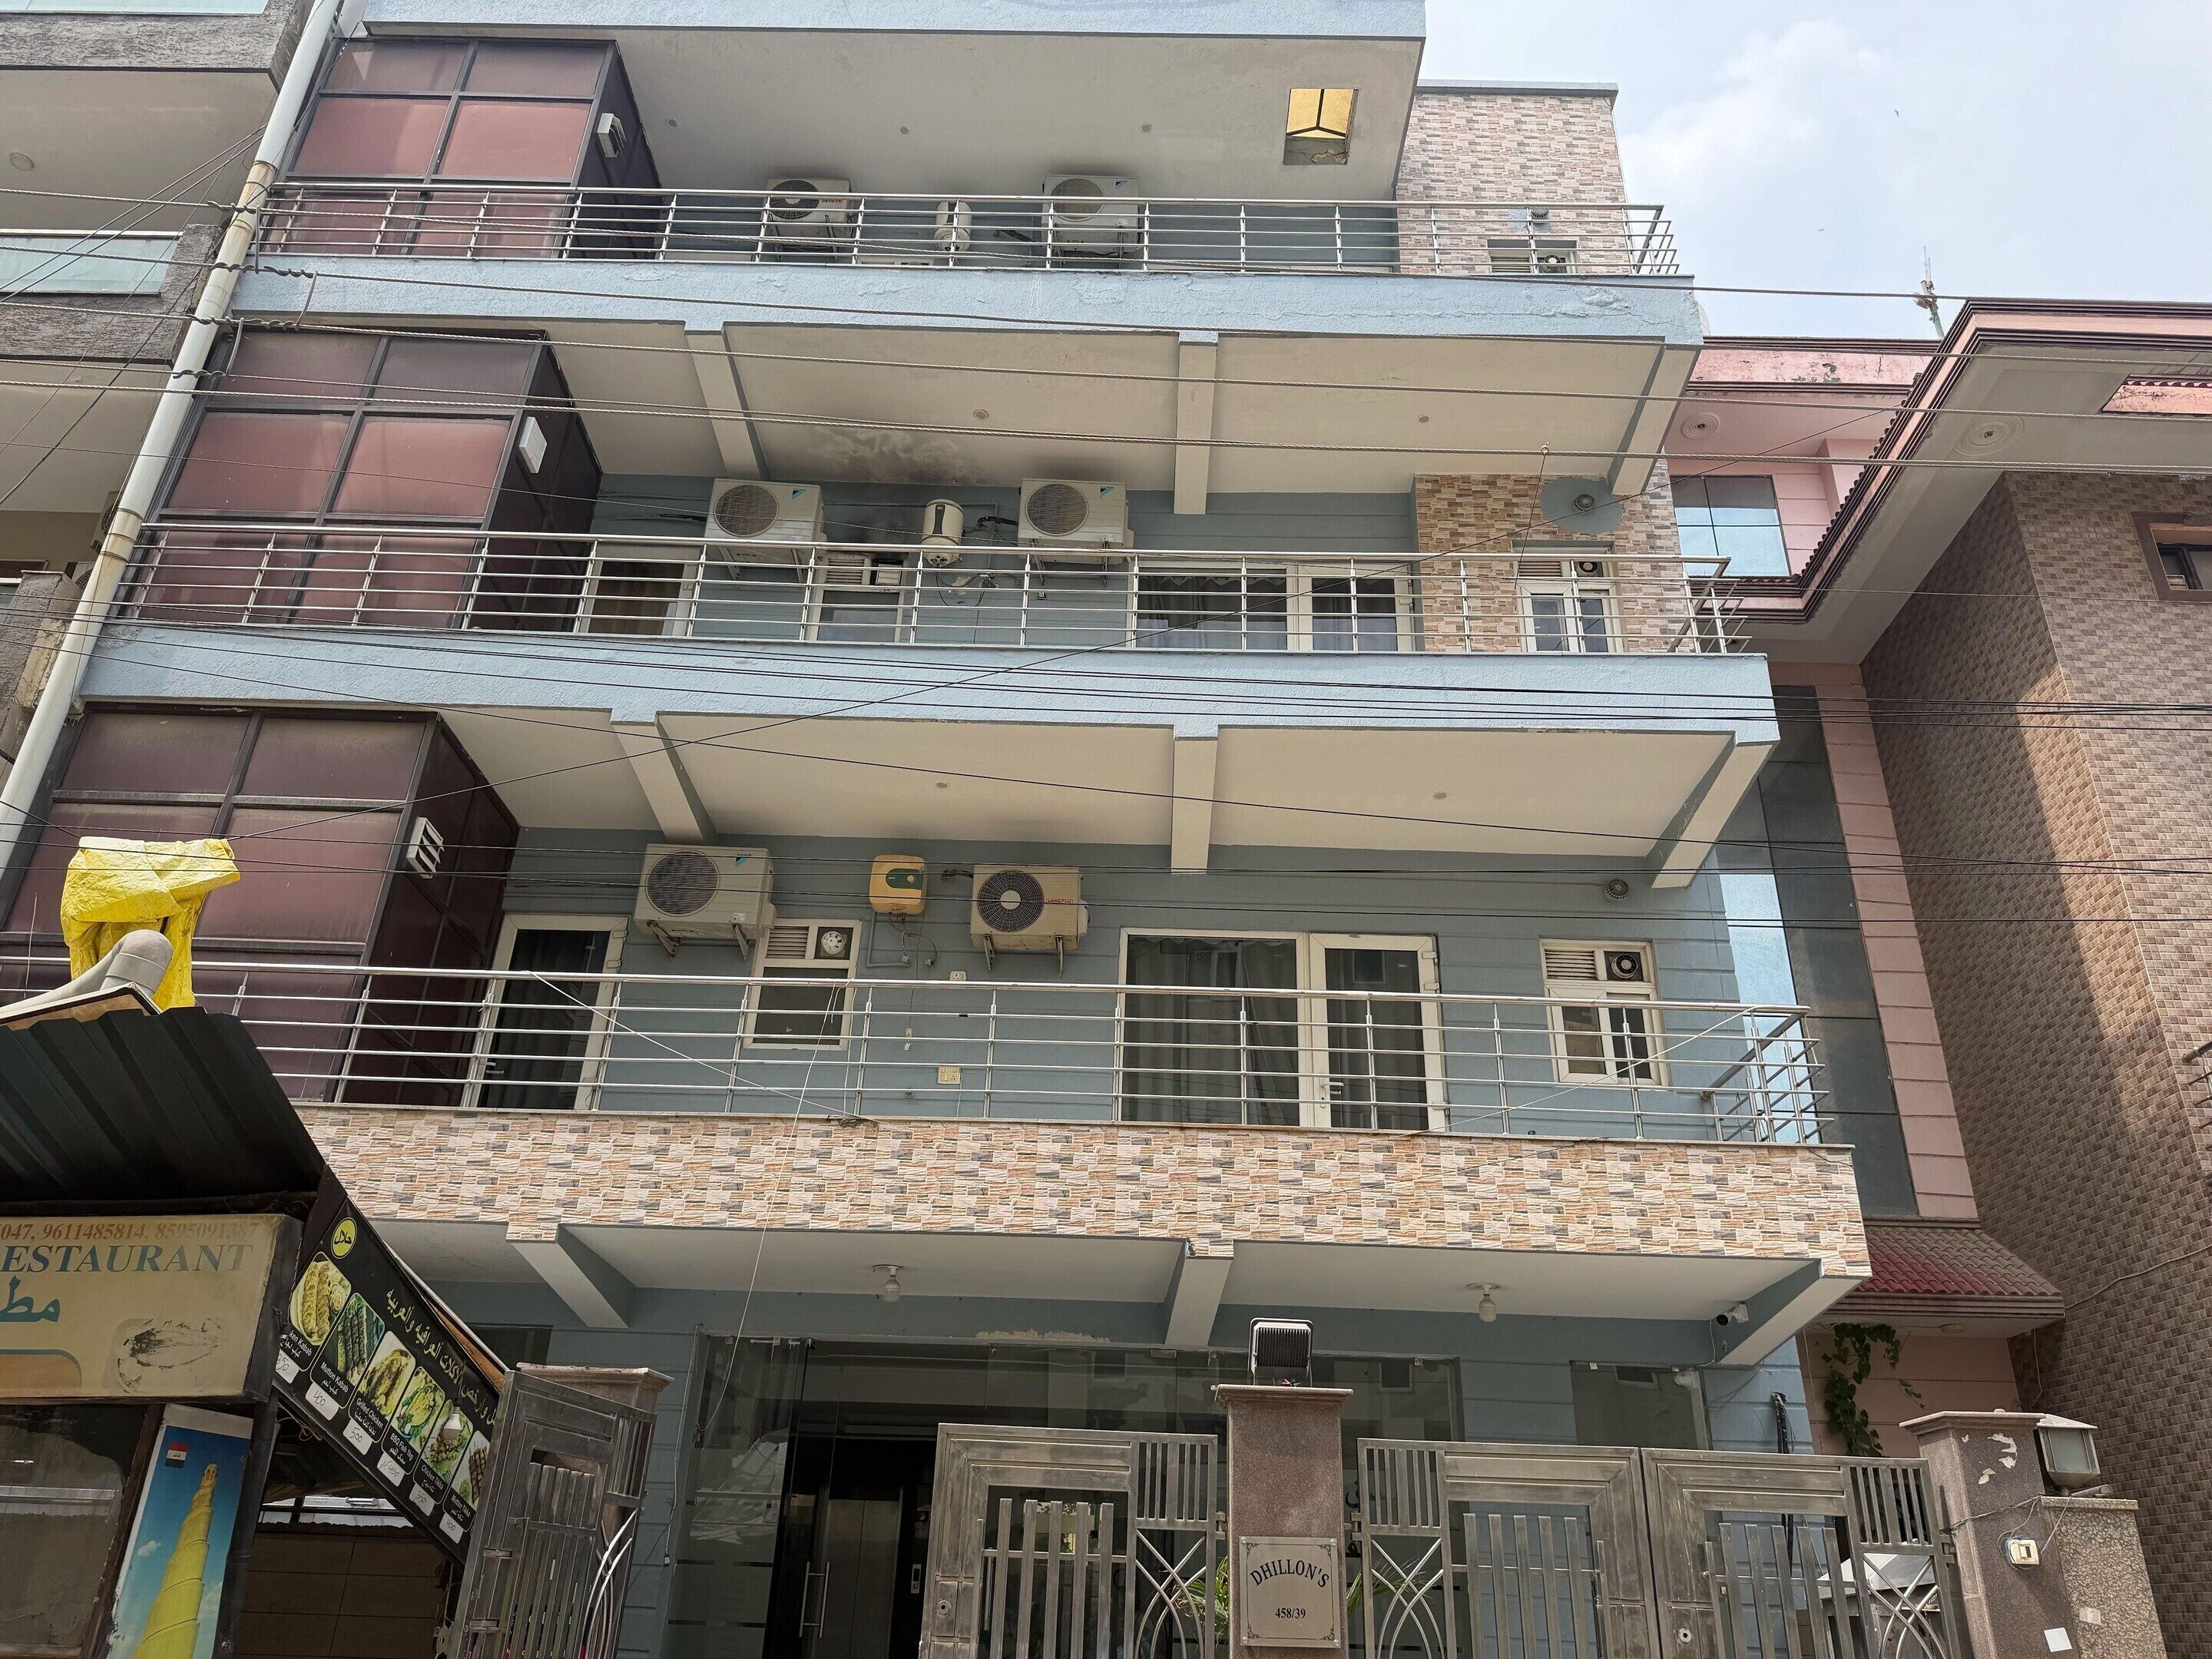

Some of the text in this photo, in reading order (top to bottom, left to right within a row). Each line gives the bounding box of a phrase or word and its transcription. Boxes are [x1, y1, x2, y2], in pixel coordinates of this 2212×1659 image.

[0, 1224, 35, 1243] 047,
[40, 1223, 148, 1243] 9611485814,
[334, 1229, 352, 1245] حلال
[289, 1330, 313, 1356] ken Kabab
[320, 1361, 349, 1393] Mutton Kabab
[313, 1390, 326, 1406] 400
[356, 1397, 383, 1429] Grilled Chicken
[349, 1426, 363, 1443] 500
[390, 1433, 400, 1445] BBQ
[399, 1442, 409, 1455] Fish
[421, 1464, 445, 1491] Chicken Tikka
[1250, 1559, 1330, 1588] DHILLON'S
[1275, 1608, 1306, 1619] 458/39
